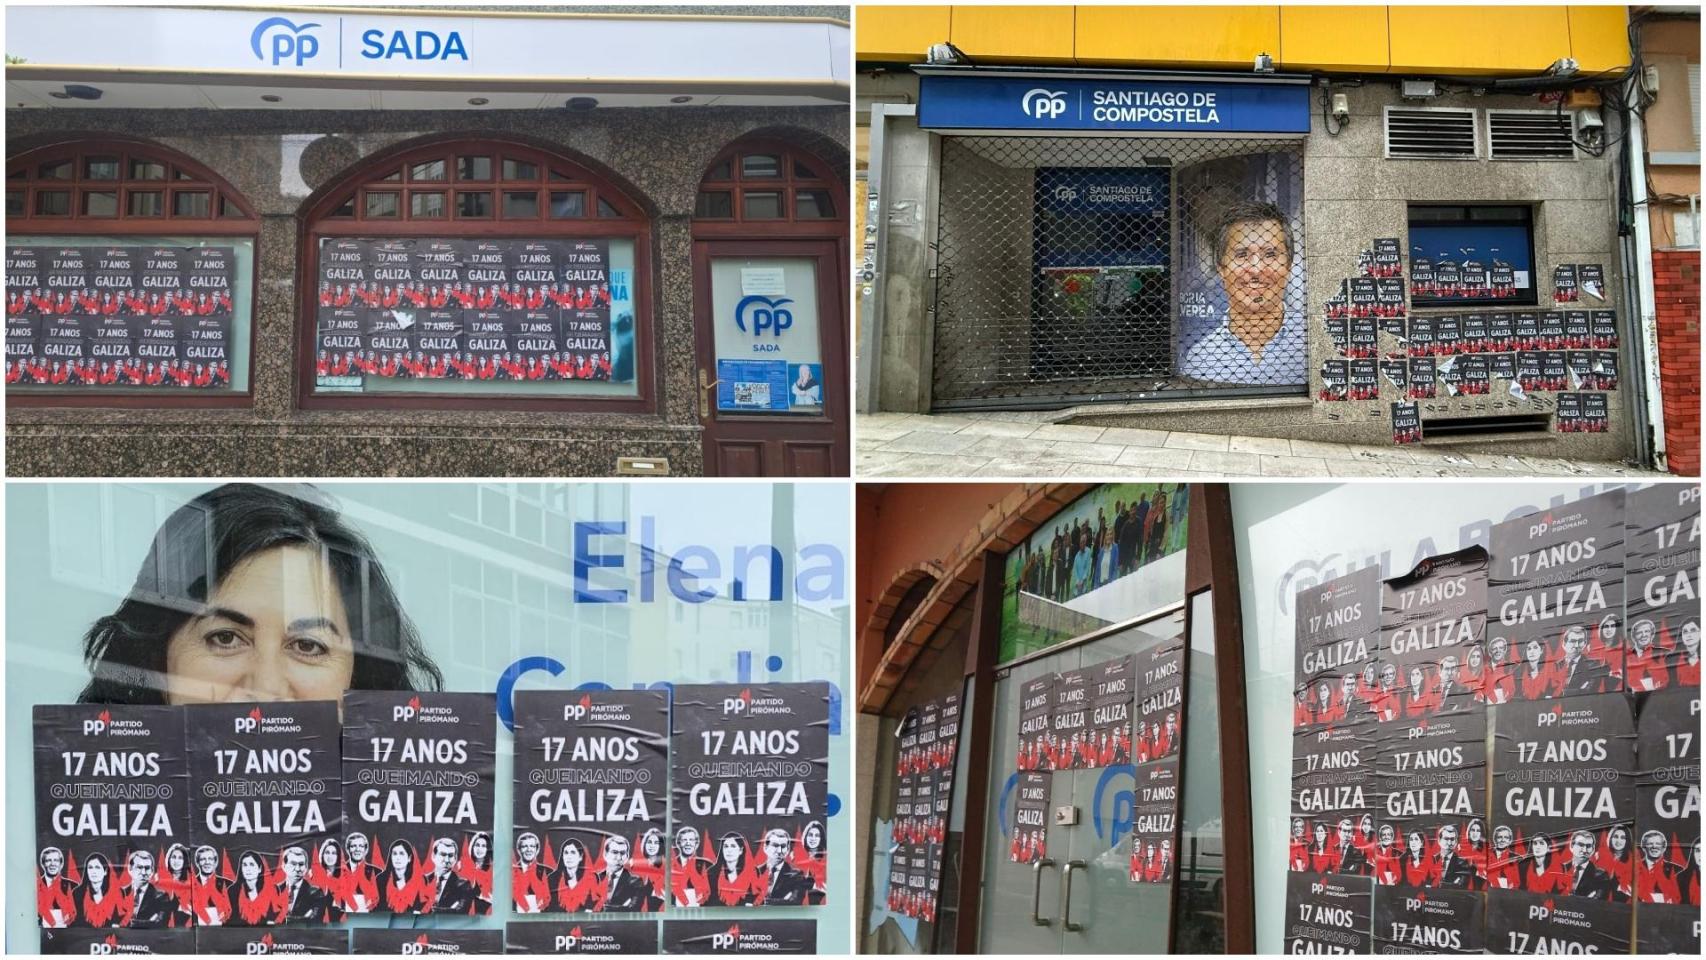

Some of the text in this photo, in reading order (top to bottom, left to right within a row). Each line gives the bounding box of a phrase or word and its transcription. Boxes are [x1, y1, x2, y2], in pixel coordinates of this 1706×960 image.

[361, 30, 468, 61] SADA
[1094, 91, 1216, 107] SANTIAGO DE
[1094, 107, 1220, 124] COMPOSTELA
[1089, 194, 1153, 202] COMPOSTELA
[1090, 186, 1152, 194] SANTIAGO DE
[54, 260, 83, 268] 17 ANOS
[147, 261, 178, 269] 17 ANOS
[203, 261, 224, 269] ANOS
[331, 253, 339, 261] 17
[387, 254, 408, 262] ANOS
[481, 255, 502, 263] ANOS
[529, 255, 551, 263] ANOS
[569, 254, 600, 263] 17 ANOS
[48, 276, 86, 287] GALIZA
[143, 277, 180, 287] GALIZA
[190, 277, 227, 287] GALIZA
[327, 269, 364, 279] GALIZA
[374, 269, 411, 279] GALIZA
[468, 270, 506, 281] GALIZA
[517, 270, 555, 281] GALIZA
[566, 270, 604, 281] GALIZA
[753, 344, 780, 352] SADA
[1585, 409, 1605, 417] GALIZA
[1552, 513, 1582, 527] PARTIDO
[1529, 524, 1548, 540] PP
[1655, 523, 1681, 550] 17
[573, 516, 845, 604] Elena
[1510, 537, 1596, 578] 17 ANOS
[1399, 577, 1467, 610] 17 ANOS
[1500, 580, 1607, 627] GALIZA
[1309, 602, 1362, 634] 17 ANOS
[1390, 616, 1474, 655] GALIZA
[1303, 636, 1368, 675] GALIZA
[1145, 660, 1178, 685] 17 ANOS
[1099, 678, 1126, 695] 17 ANOS
[591, 705, 624, 713] PARTIDO
[723, 698, 745, 715] PP
[750, 698, 783, 706] PARTIDO
[1025, 693, 1047, 710] 17 ANOS
[1142, 686, 1181, 716] GALIZA
[393, 706, 414, 722] PP
[564, 704, 585, 721] PP
[591, 712, 630, 722] PIRÓMANO
[750, 705, 791, 715] PIRÓMANO
[1094, 703, 1127, 724] GALIZA
[1562, 709, 1593, 719] PARTIDO
[110, 720, 143, 728] PARTIDO
[235, 717, 256, 734] PP
[261, 717, 294, 725] PARTIDO
[420, 715, 459, 724] PIRÓMANO
[1022, 714, 1048, 734] GALIZA
[1426, 722, 1451, 731] PARTIDO
[1538, 711, 1556, 727] PP
[1562, 716, 1600, 726] PIRÓMANO
[83, 720, 105, 736] PP
[110, 727, 150, 736] PIRÓMANO
[261, 724, 301, 734] PIRÓMANO
[939, 723, 958, 738] GALIZA
[1408, 725, 1423, 740] PP
[1426, 728, 1456, 738] PIRÓMANO
[702, 730, 800, 756] 17 ANOS
[919, 730, 936, 744] GALIZA
[1318, 730, 1330, 743] PP
[371, 738, 468, 764] 17 ANOS
[541, 737, 639, 762] 17 ANOS
[1517, 738, 1607, 763] 17 ANOS
[1666, 733, 1693, 759] 17
[62, 752, 160, 776] 17 ANOS
[214, 748, 312, 774] 17 ANOS
[1306, 750, 1360, 772] 17 ANOS
[1394, 746, 1463, 772] 17 ANOS
[528, 768, 650, 785] QUEIMANDO
[688, 761, 811, 778] QUEIMANDO
[1505, 767, 1619, 783] QUEIMANDO
[358, 769, 479, 787] QUEIMANDO
[50, 783, 173, 800] QUEIMANDO
[202, 779, 325, 796] QUEIMANDO
[1022, 788, 1044, 800] 17 ANOS
[529, 788, 650, 822] GALIZA
[689, 781, 811, 816] GALIZA
[1300, 785, 1366, 811] GALIZA
[1387, 787, 1473, 817] GALIZA
[1505, 787, 1617, 819] GALIZA
[358, 789, 478, 825] GALIZA
[52, 804, 173, 837] GALIZA
[205, 799, 326, 834] GALIZA
[1017, 808, 1044, 826] GALIZA
[1312, 882, 1324, 895] PP
[1406, 898, 1421, 911] PP
[1425, 900, 1449, 908] PARTIDO
[1425, 907, 1454, 915] PIRÓMANO
[1299, 903, 1353, 928] 17 ANOS
[1529, 904, 1548, 921] PP
[1553, 908, 1585, 920] PARTIDO
[1553, 917, 1591, 929] PIRÓMANO
[555, 935, 576, 952] PP
[581, 935, 614, 943] PARTIDO
[712, 933, 734, 950] PP
[739, 933, 772, 942] PARTIDO
[1391, 922, 1461, 950] 17 ANOS
[1508, 931, 1530, 954] 17
[581, 942, 621, 951] PIRÓMANO
[739, 941, 779, 950] PIRÓMANO
